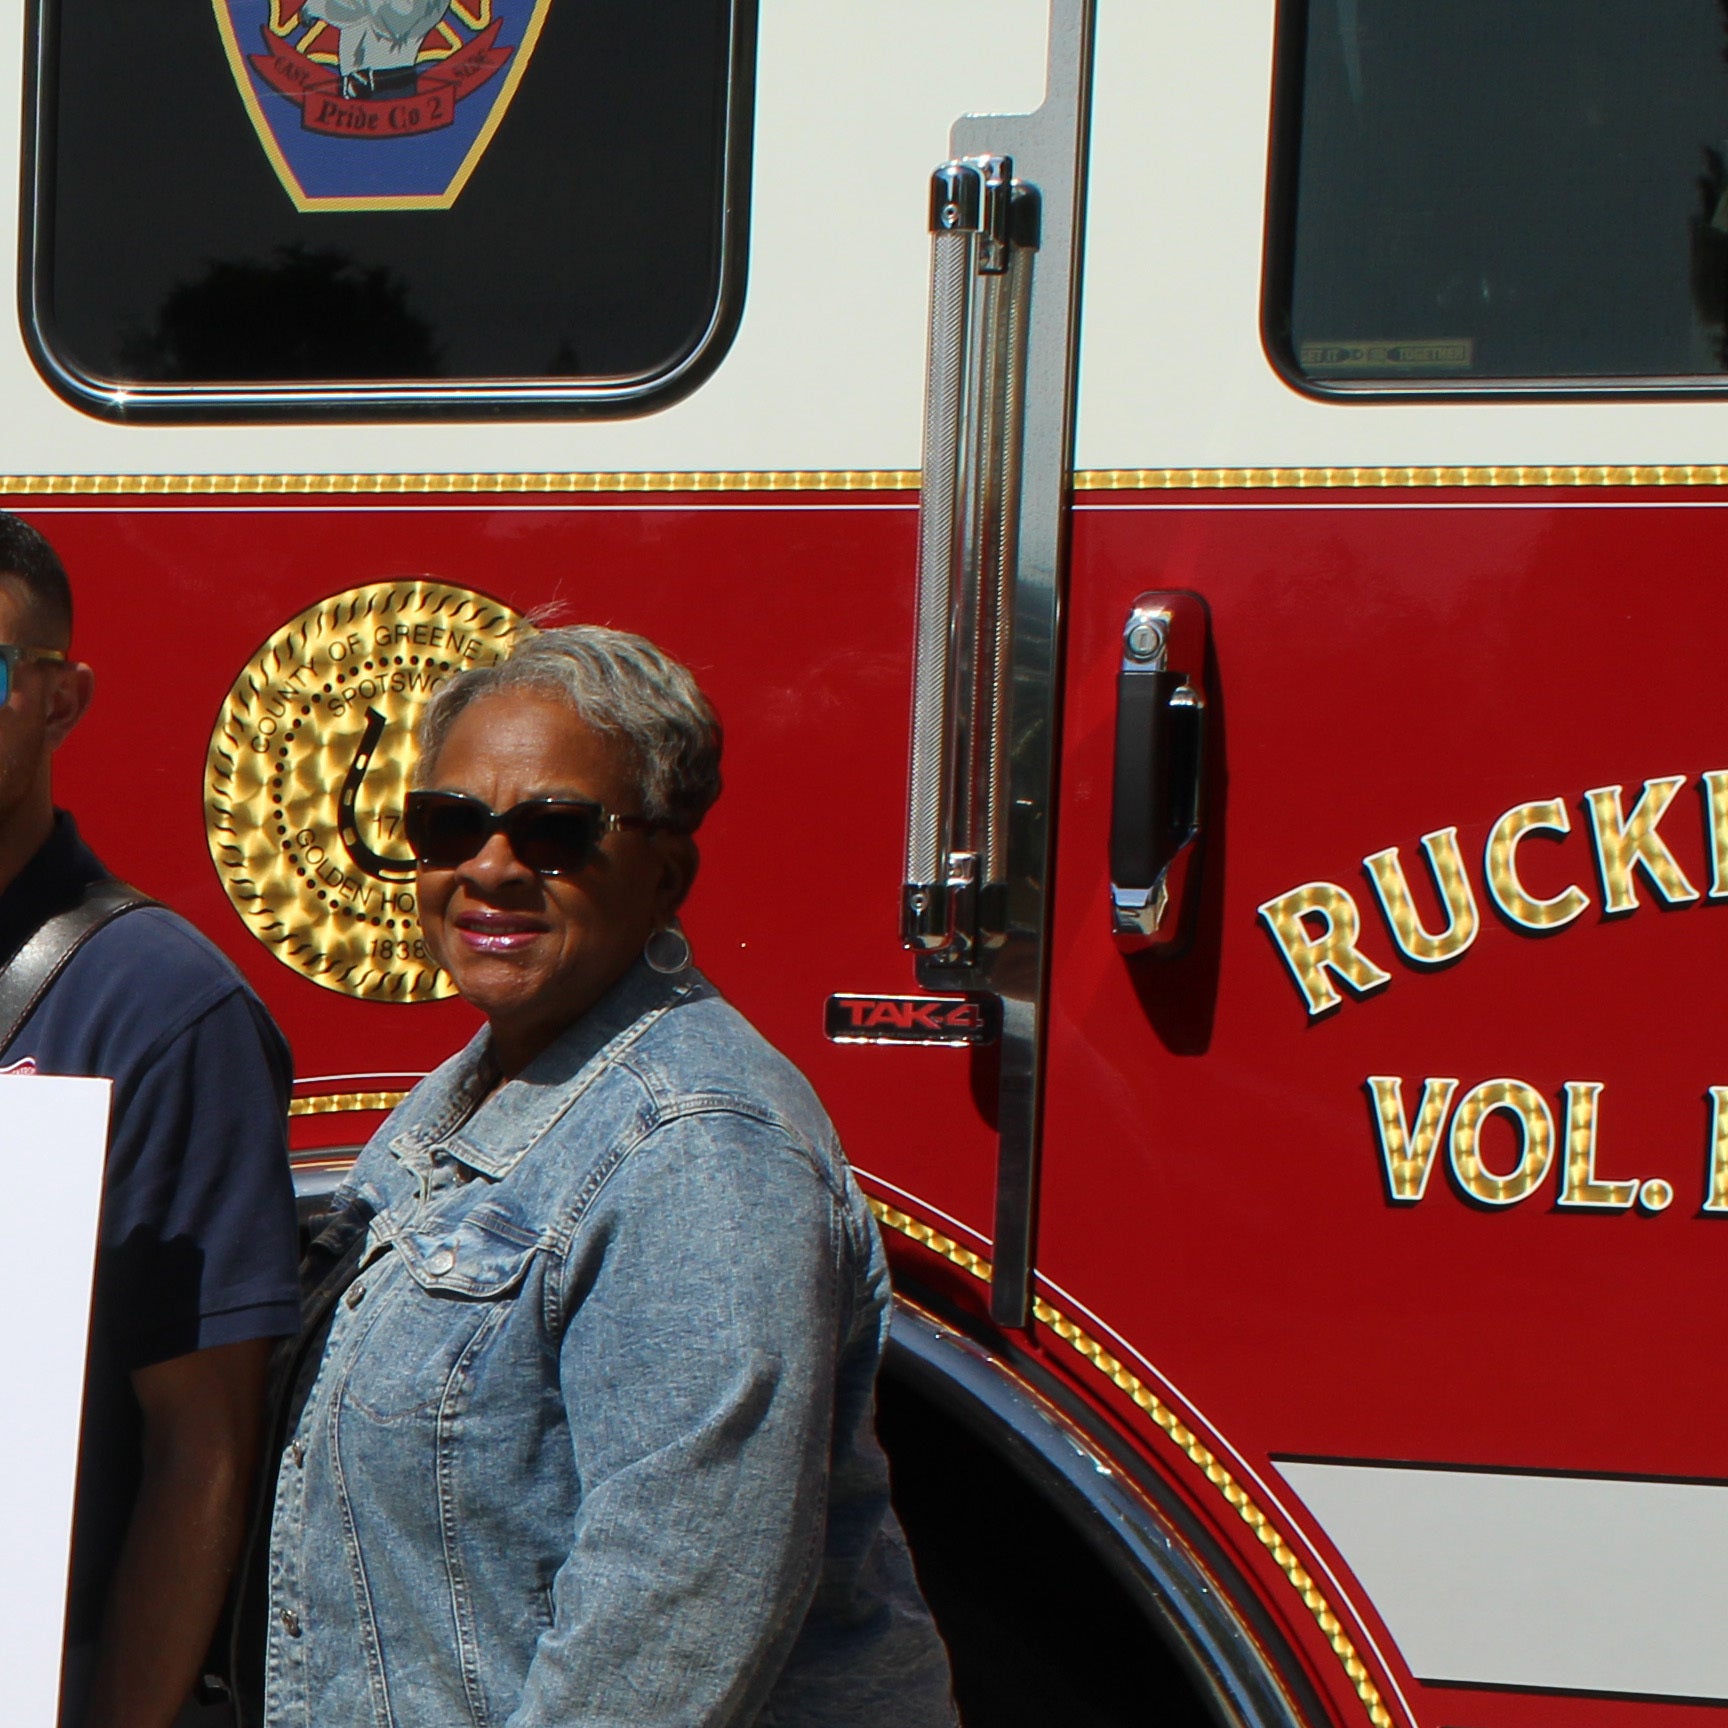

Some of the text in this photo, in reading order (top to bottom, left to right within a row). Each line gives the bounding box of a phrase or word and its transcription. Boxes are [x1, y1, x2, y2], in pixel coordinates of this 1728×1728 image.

[315, 97, 443, 130] Pride Co 2
[251, 657, 319, 753] COUNTY
[328, 633, 361, 662] OF
[374, 624, 484, 661] GREENE
[295, 828, 373, 907] GOLDEN
[371, 939, 425, 960] 1838
[839, 1000, 984, 1030] TAK-4
[1366, 1075, 1674, 1211] VOL.
